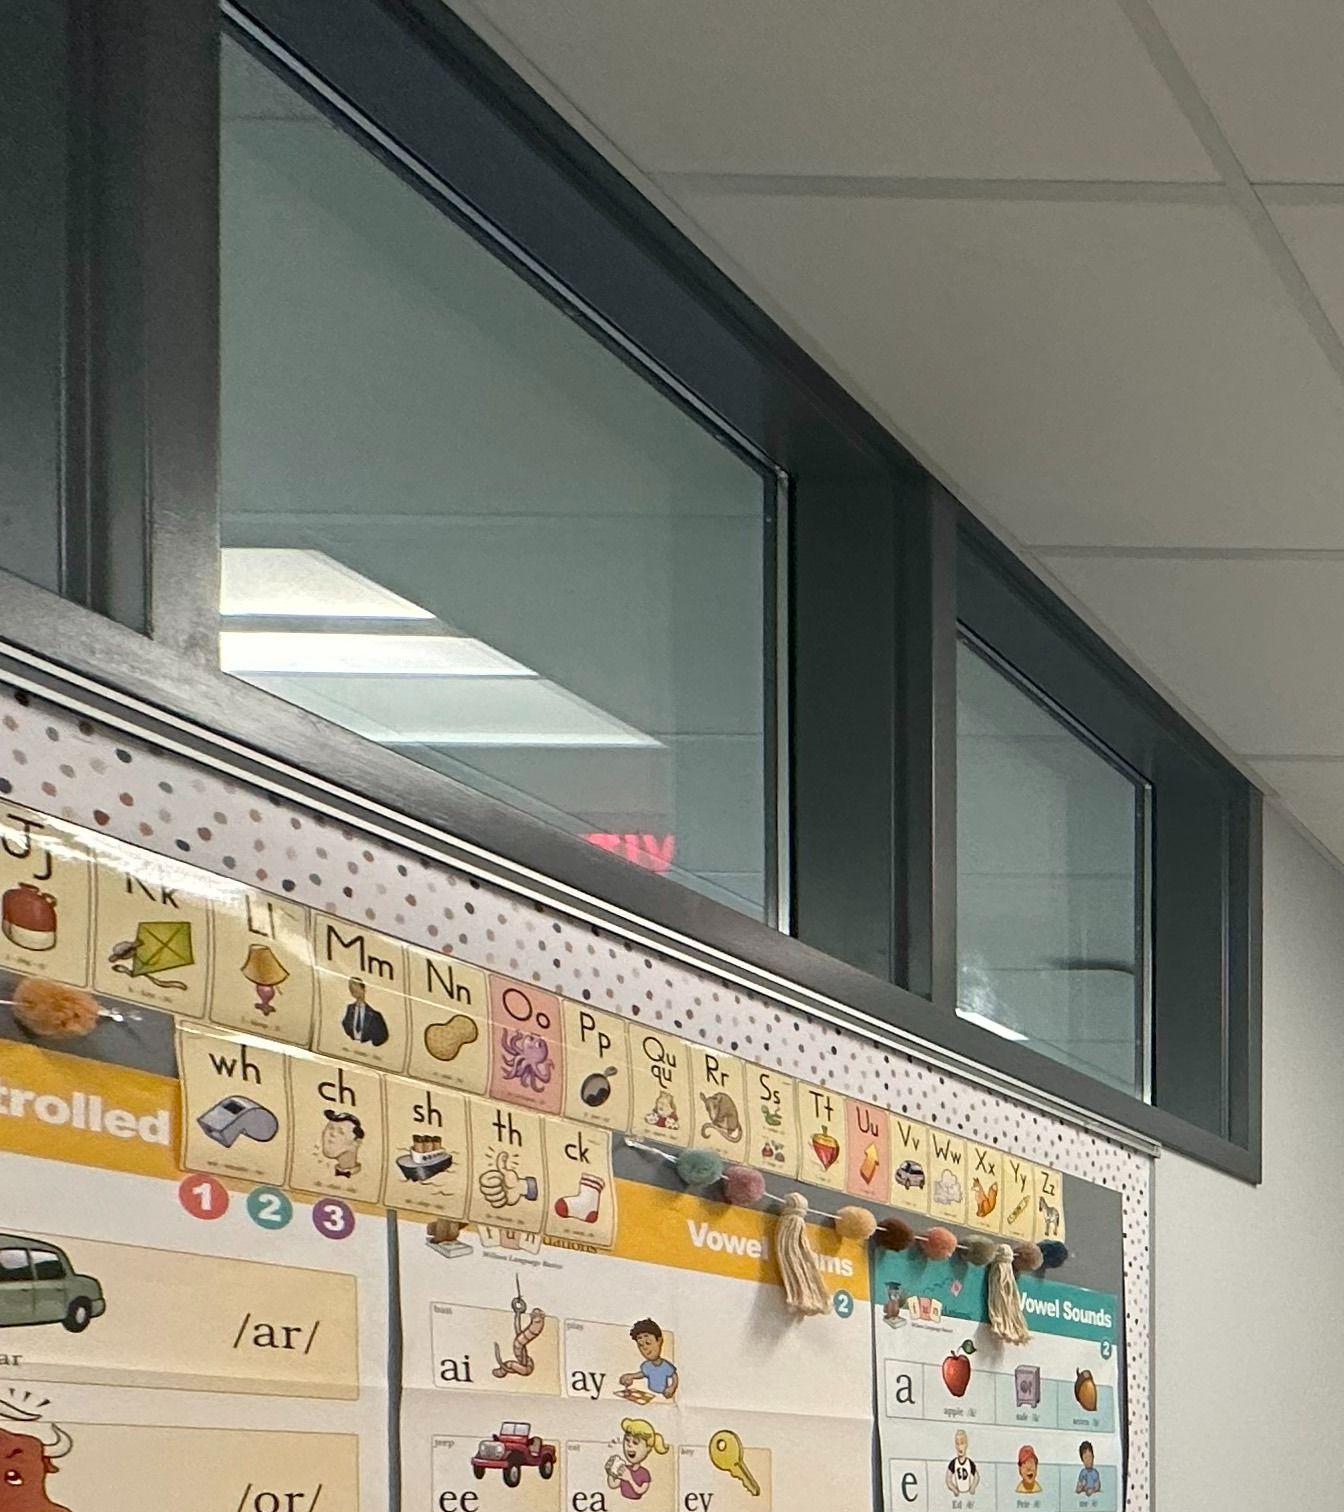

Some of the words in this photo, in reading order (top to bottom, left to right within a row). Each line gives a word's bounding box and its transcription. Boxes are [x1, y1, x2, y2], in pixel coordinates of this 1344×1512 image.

[326, 924, 394, 981] Mm
[426, 960, 472, 1006] Nn
[502, 987, 551, 1030] Oo
[580, 1012, 611, 1059] Pp
[208, 1043, 261, 1085] wh
[642, 1036, 676, 1069] Qu
[651, 1062, 672, 1089] qu
[705, 1054, 730, 1088] Rr
[318, 1069, 357, 1107] ch
[759, 1074, 781, 1105] Ss
[413, 1092, 443, 1128] sh
[810, 1091, 834, 1122] Tt
[856, 1106, 880, 1138] Uu
[493, 1110, 522, 1148] th
[564, 1126, 591, 1165] ck
[897, 1121, 921, 1150] Vv
[931, 1133, 962, 1166] Ww
[975, 1148, 996, 1177] Xx
[1009, 1160, 1028, 1195] Yy
[1039, 1171, 1056, 1197] Zz
[192, 1182, 212, 1211] 1
[258, 1193, 282, 1222] 2
[322, 1204, 345, 1232] 3
[687, 1220, 768, 1260] Vowel
[838, 1295, 849, 1313] 2
[1063, 1301, 1113, 1328] Sounds
[233, 1313, 320, 1354] /ar/
[1102, 1341, 1110, 1356] 2
[440, 1355, 473, 1383] ai
[571, 1368, 606, 1399] ay
[895, 1374, 916, 1405] a
[901, 1471, 918, 1502] e
